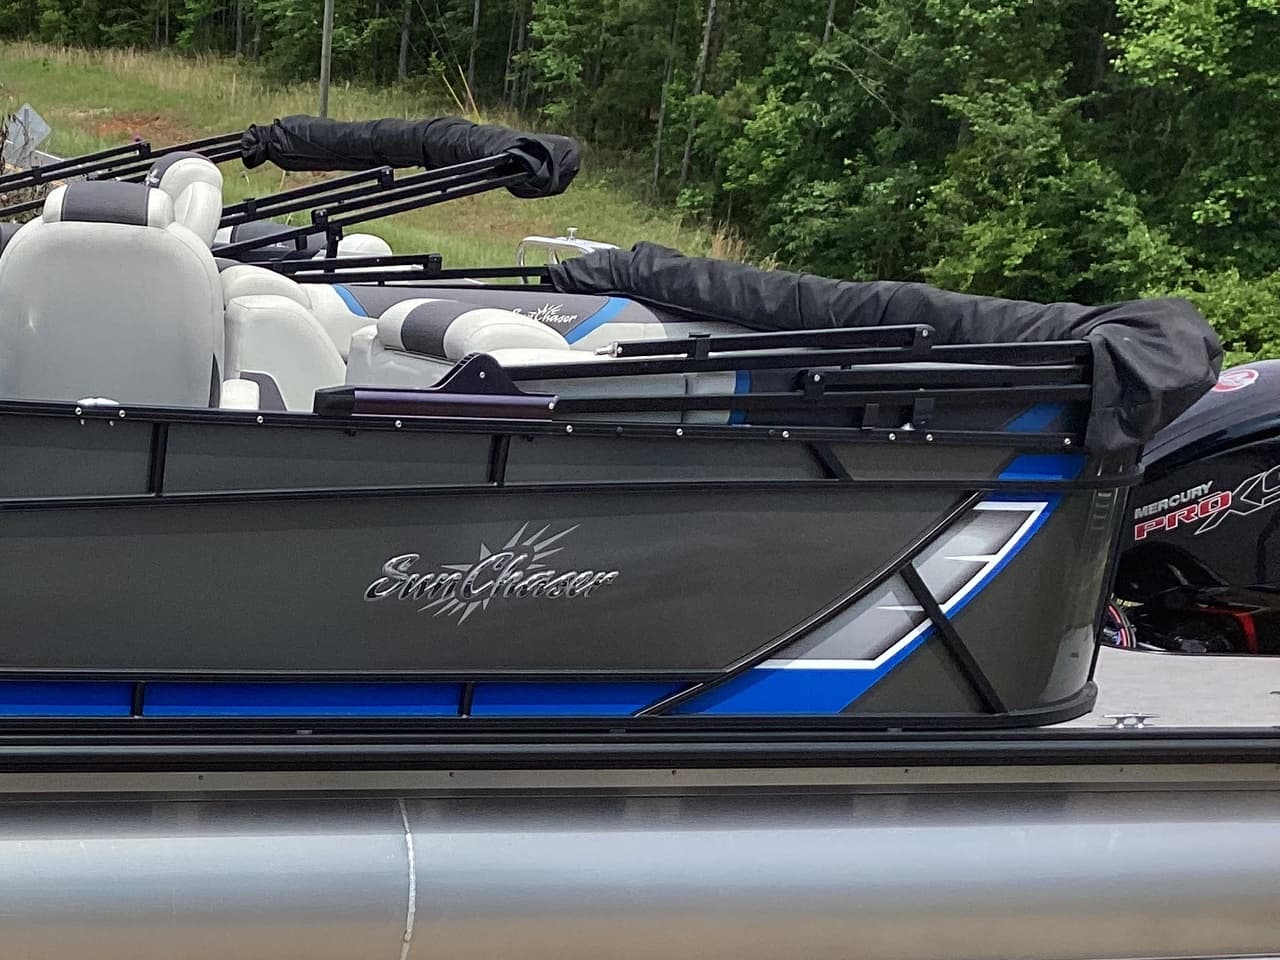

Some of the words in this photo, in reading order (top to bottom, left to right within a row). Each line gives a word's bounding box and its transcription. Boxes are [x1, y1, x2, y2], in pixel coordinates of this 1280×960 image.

[512, 308, 578, 323] Chaser
[1134, 480, 1214, 520] MERCURY
[363, 552, 620, 601] SunChaser
